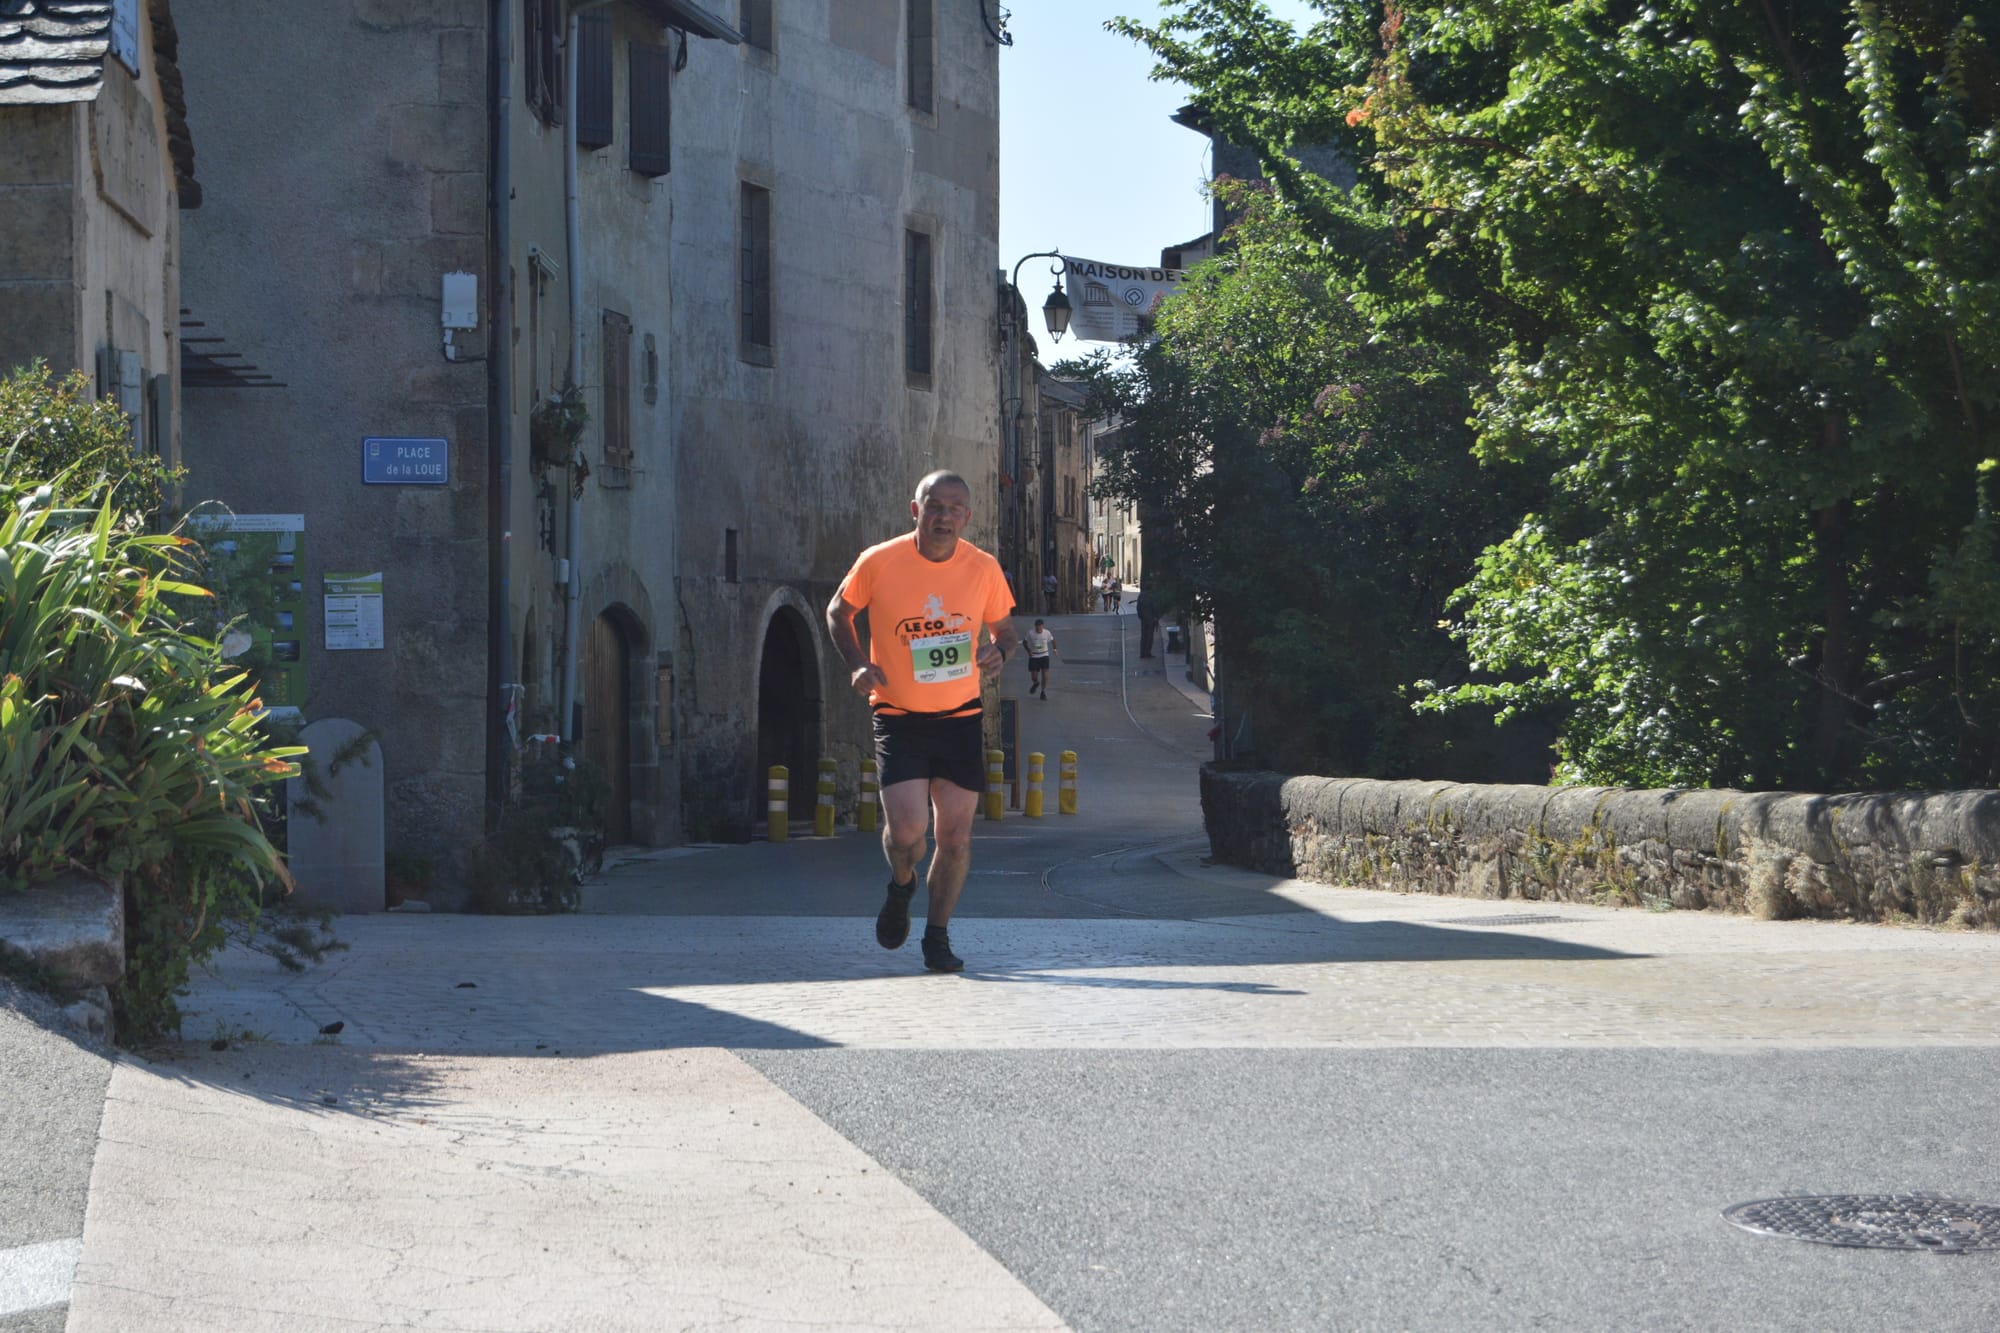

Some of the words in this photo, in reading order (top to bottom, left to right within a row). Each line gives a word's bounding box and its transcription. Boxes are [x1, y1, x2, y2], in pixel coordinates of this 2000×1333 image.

[1069, 261, 1146, 281] MAISON
[1151, 270, 1176, 282] DE
[397, 447, 431, 458] PLACE
[386, 464, 399, 475] de
[402, 464, 412, 475] la
[415, 464, 442, 475] LOUE
[904, 622, 922, 633] LE
[929, 646, 959, 668] 99
